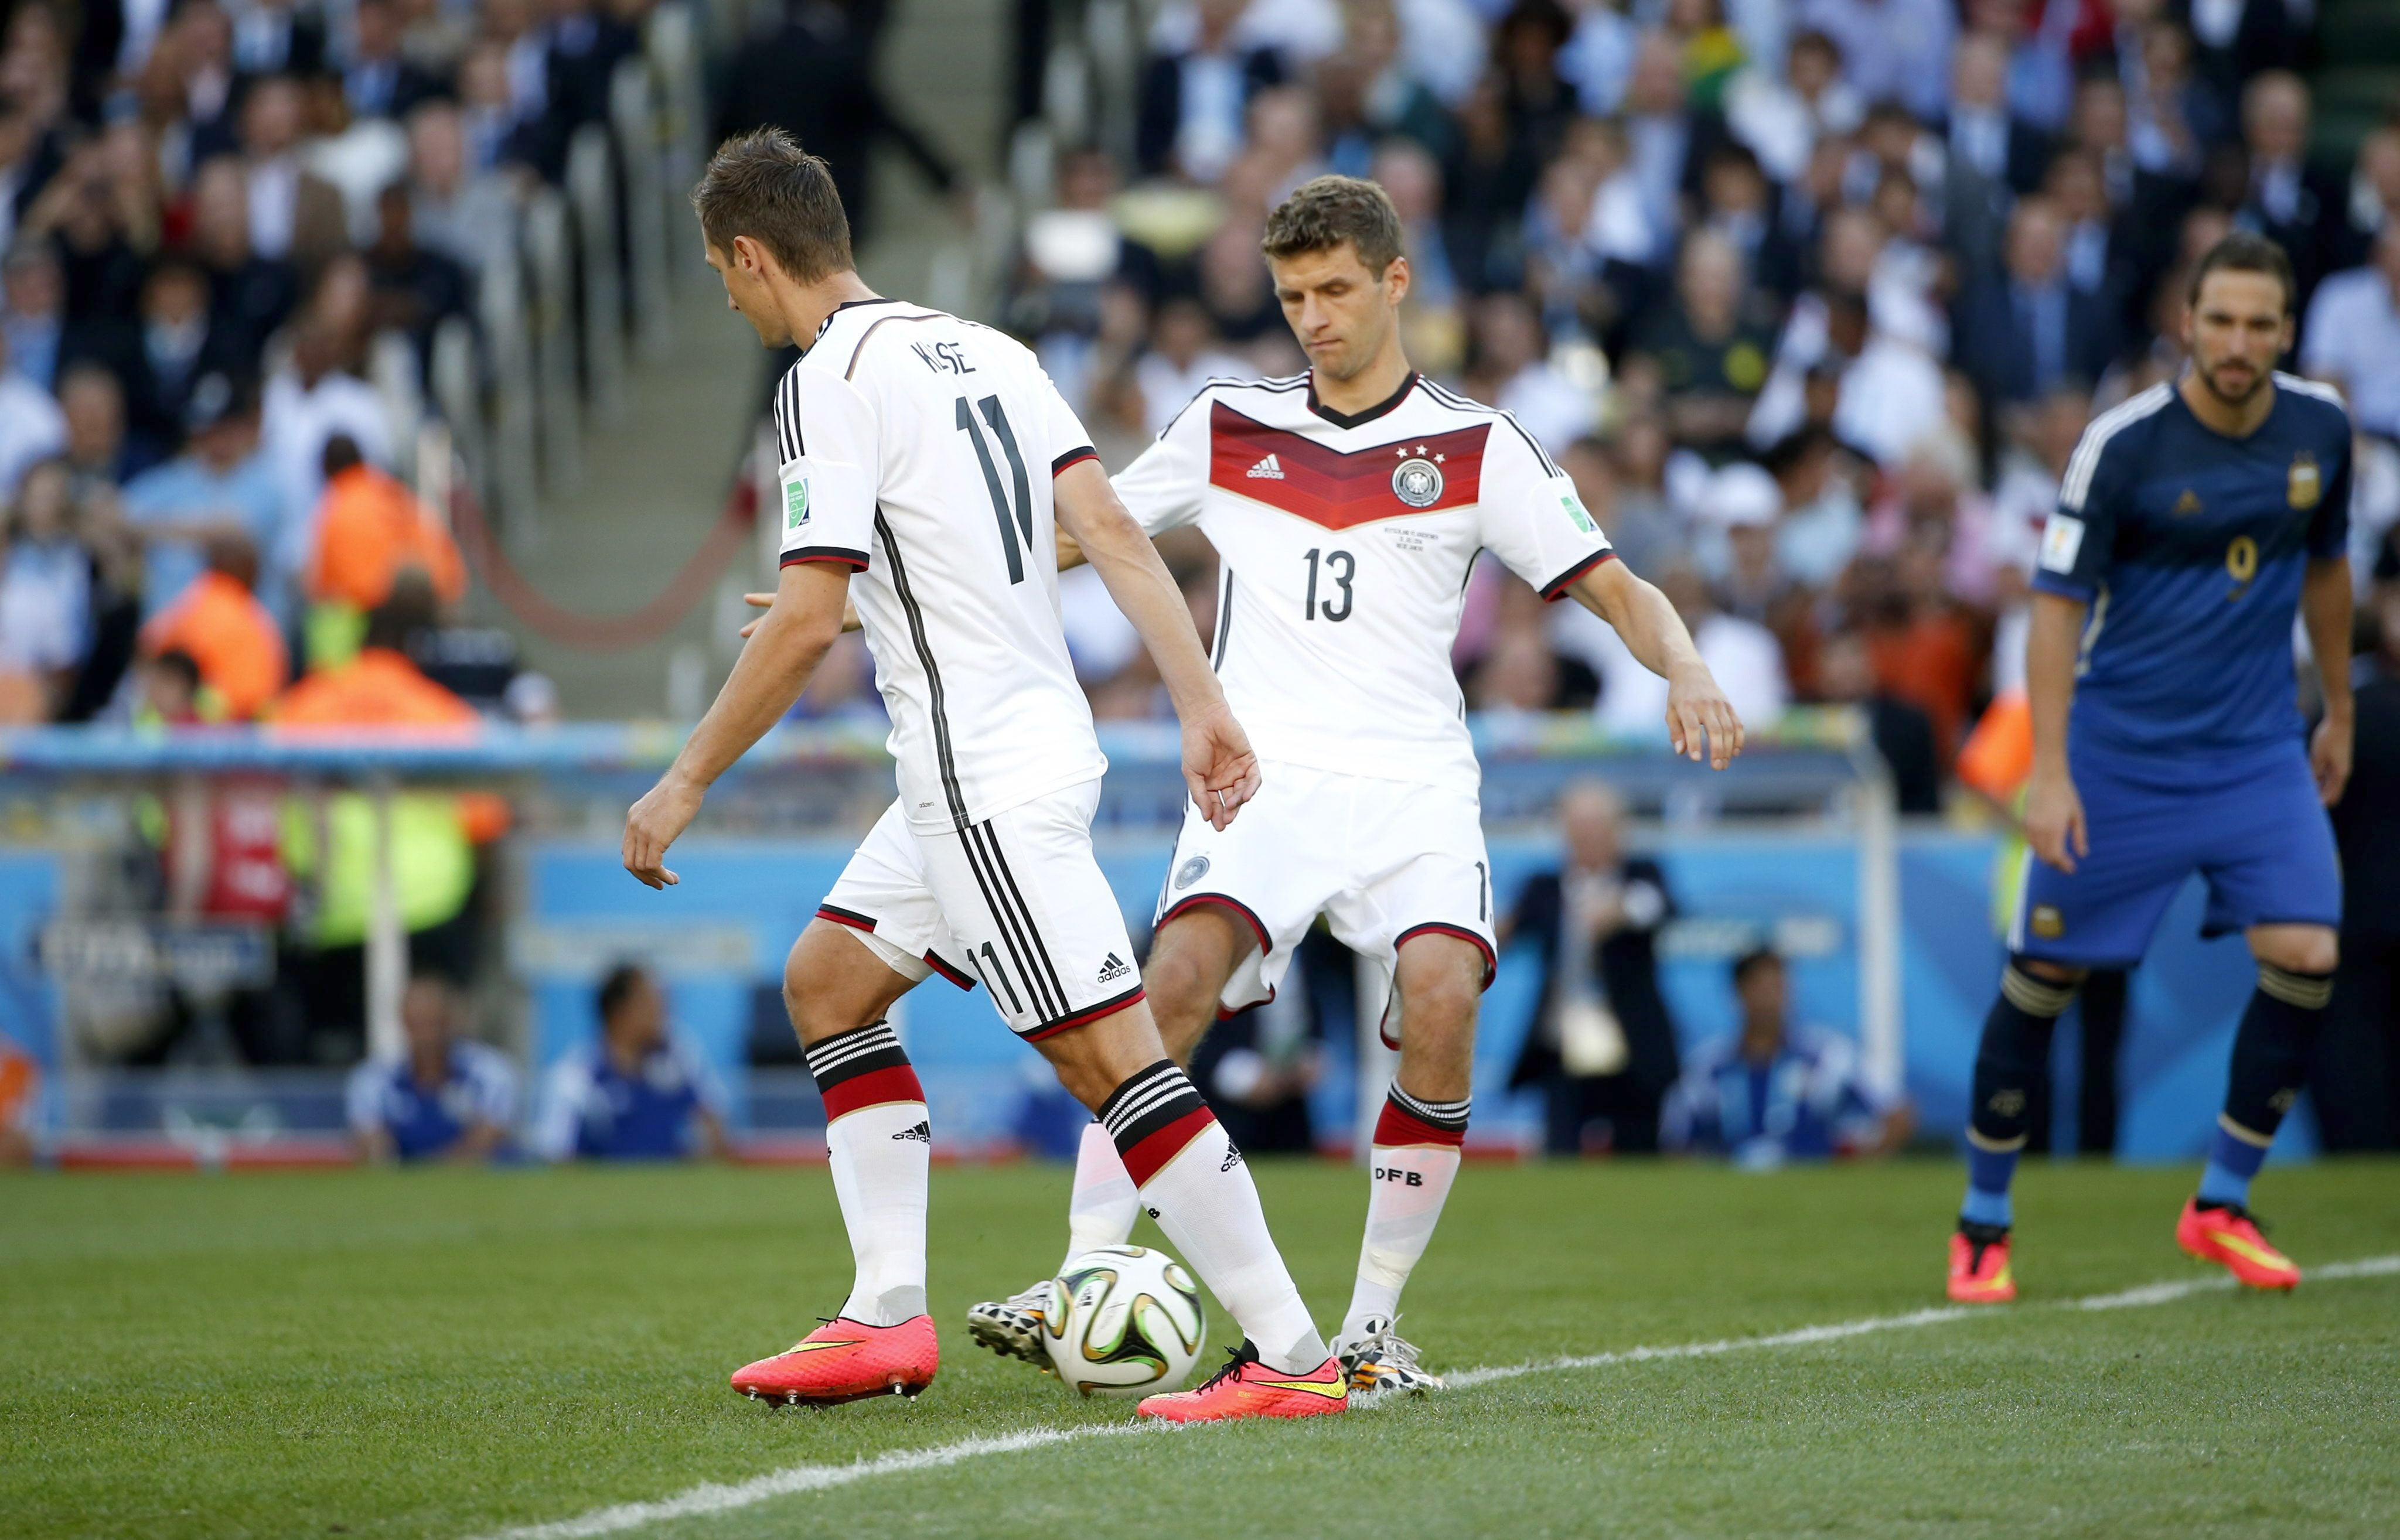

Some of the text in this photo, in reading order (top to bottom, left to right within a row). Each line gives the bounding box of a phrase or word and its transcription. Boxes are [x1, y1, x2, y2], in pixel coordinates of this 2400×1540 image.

[956, 394, 1033, 586] 11
[1246, 469, 1285, 480] adidas
[1303, 548, 1356, 622] 13
[2225, 535, 2258, 603] 9
[1474, 861, 1492, 927] 1
[966, 940, 1024, 1019] 11
[1097, 965, 1131, 984] adidas
[1375, 1167, 1423, 1187] DFB
